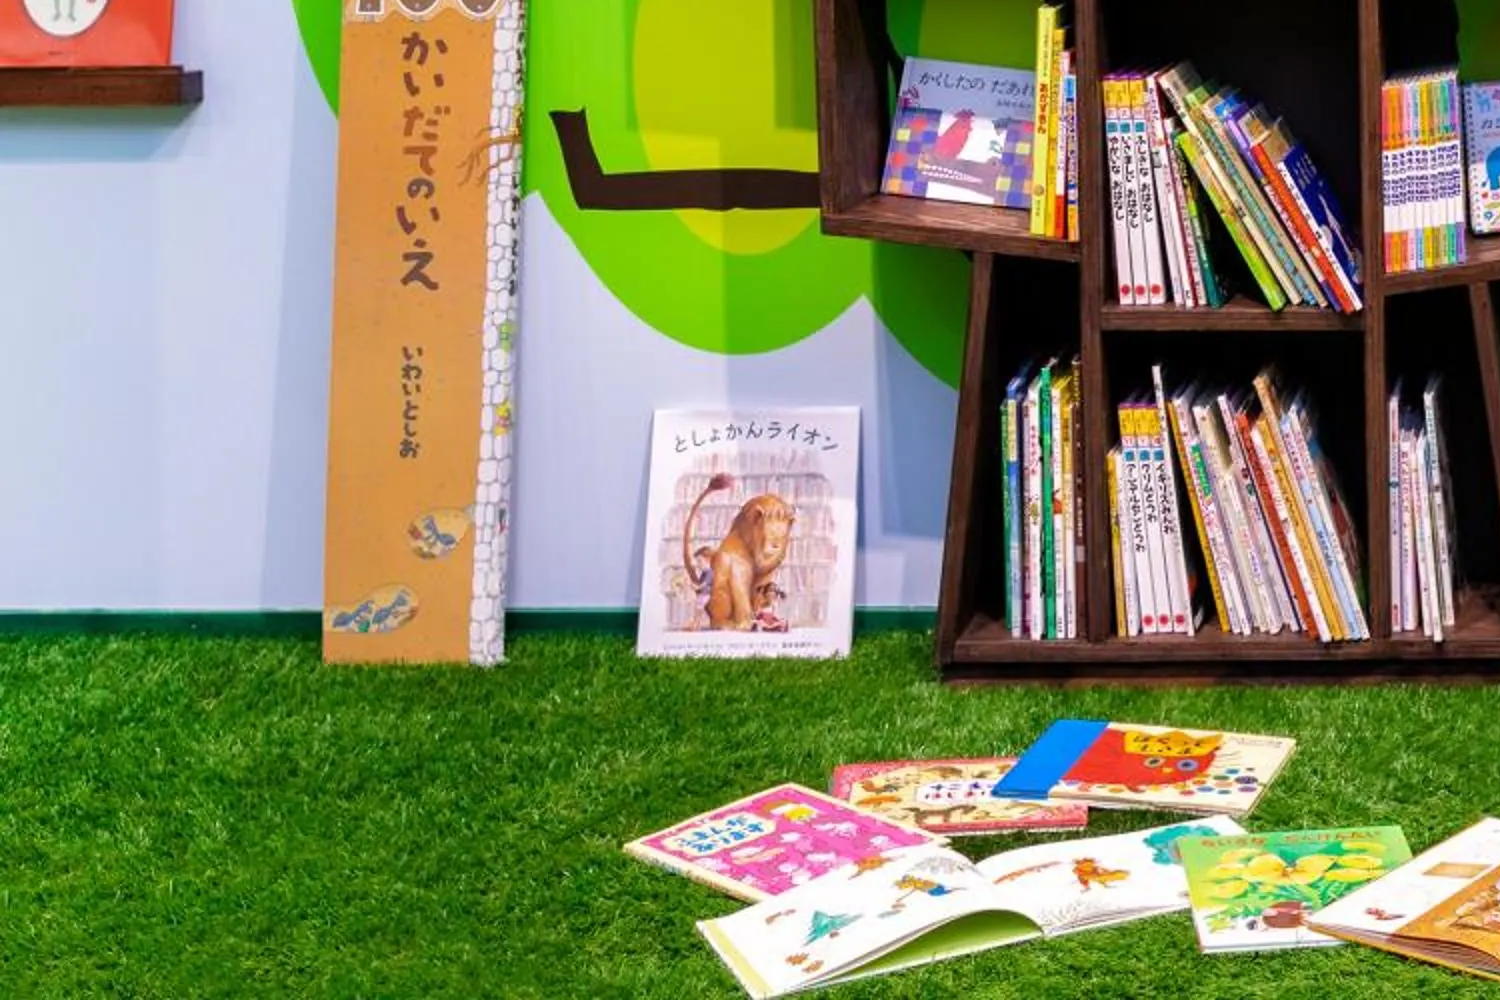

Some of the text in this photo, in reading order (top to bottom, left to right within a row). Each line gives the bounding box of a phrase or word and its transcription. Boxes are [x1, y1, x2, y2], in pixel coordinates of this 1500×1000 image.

[918, 71, 986, 92] かくしたの
[396, 31, 452, 291] かいだてのいえ
[399, 345, 424, 459] いわいとしお
[674, 421, 839, 453] としょかんライオン
